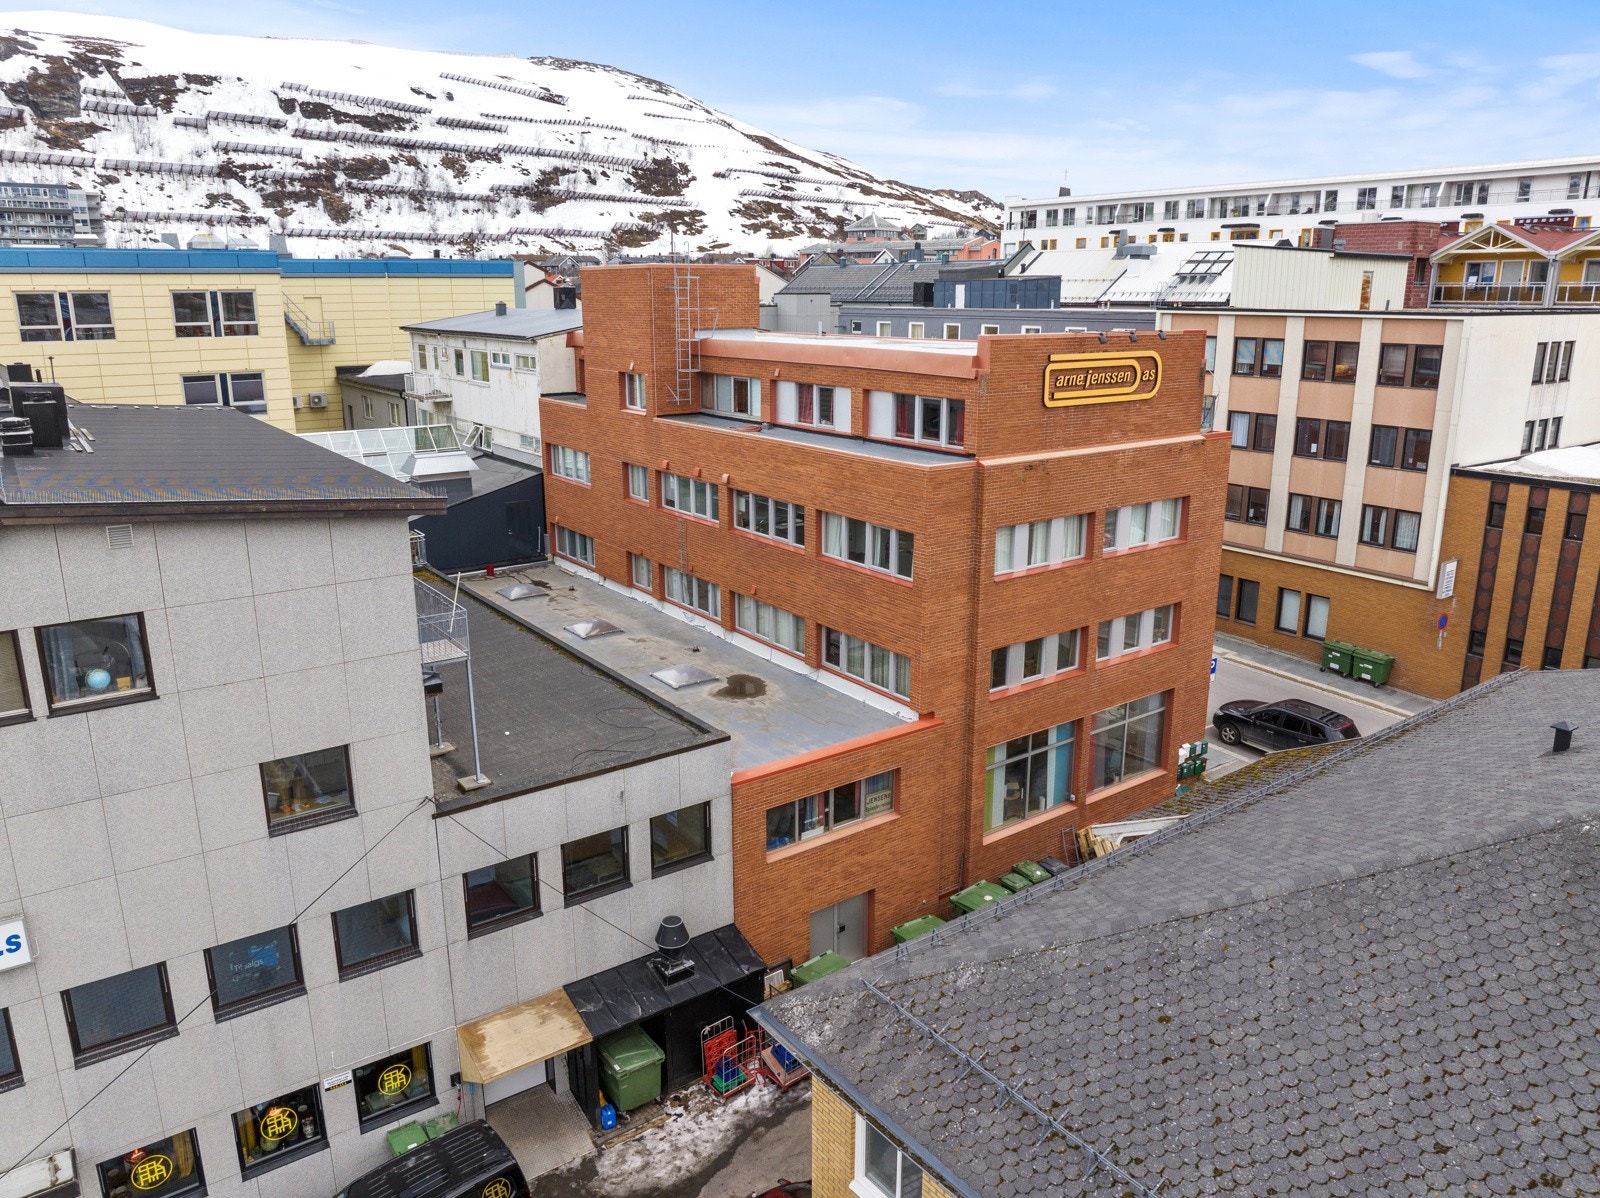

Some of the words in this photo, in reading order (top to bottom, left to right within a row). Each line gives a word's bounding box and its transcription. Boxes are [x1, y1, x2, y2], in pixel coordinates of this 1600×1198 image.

[1056, 373, 1084, 387] arne
[1084, 370, 1131, 389] jenssen
[1142, 369, 1156, 381] as
